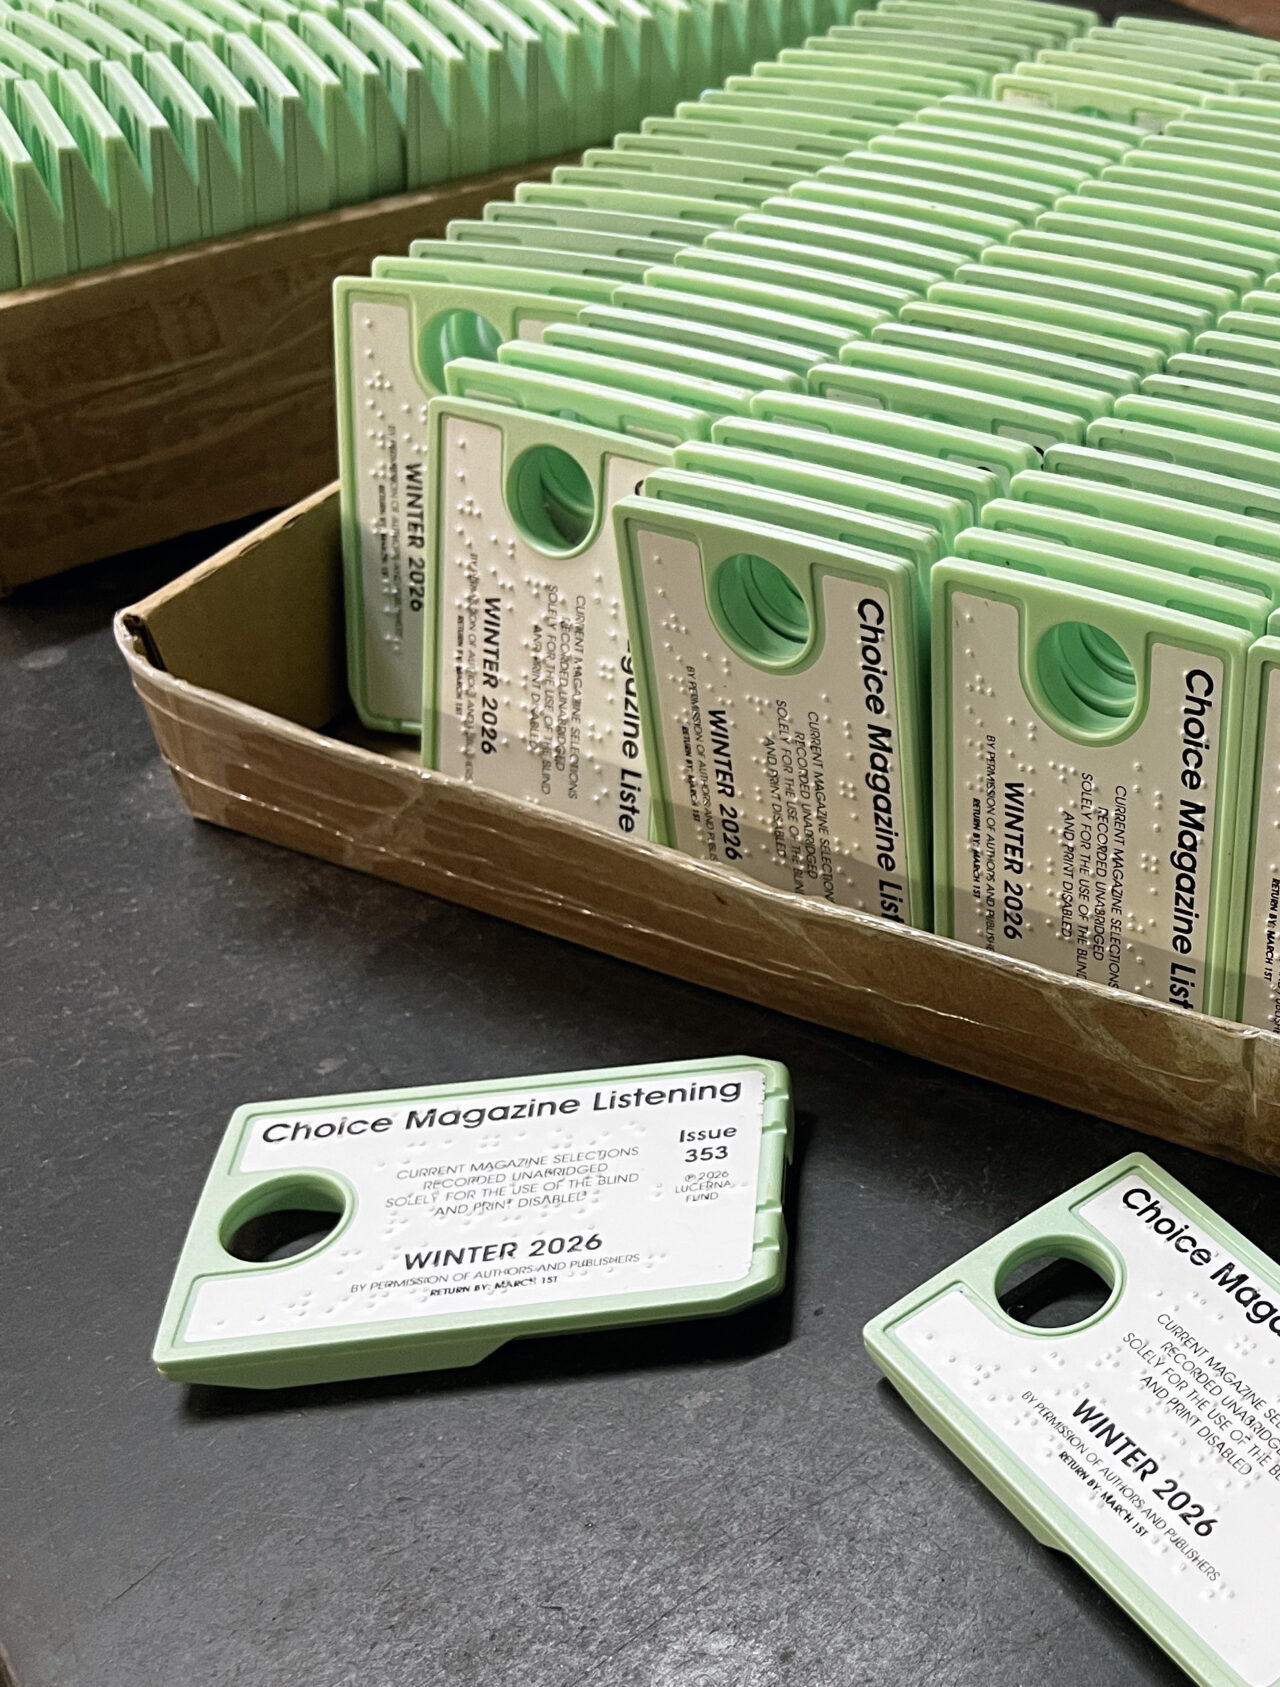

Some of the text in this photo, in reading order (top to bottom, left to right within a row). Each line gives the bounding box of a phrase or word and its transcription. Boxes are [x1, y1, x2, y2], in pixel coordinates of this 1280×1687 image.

[479, 596, 501, 755] WINTER 2026
[857, 597, 889, 717] Choice
[1179, 668, 1214, 793] Choice
[706, 709, 743, 861] WINTER 2026
[863, 722, 899, 872] Magazine
[1079, 771, 1093, 820] SOLELY
[1112, 784, 1127, 846] CURRENT
[1003, 781, 1024, 940] WINTER 2026
[1078, 853, 1091, 875] THE
[1079, 822, 1092, 850] FOR
[1077, 877, 1090, 902] USE
[1110, 847, 1124, 915] MAGAZINE
[1168, 798, 1207, 955] Magazine
[1076, 924, 1089, 946] THE
[1077, 903, 1089, 923] OF
[1263, 876, 1280, 981] RETURN BY: MARCH 1ST
[260, 1081, 742, 1144] Choice Magazine Listening
[678, 1126, 737, 1143] Issue
[395, 1145, 639, 1180] CURRENT MAGAZINE SELECTIONS
[673, 1179, 731, 1193] LUCERNA
[683, 1144, 728, 1163] 353
[444, 1188, 476, 1202] FOR
[481, 1185, 506, 1198] THE
[510, 1182, 538, 1195] USE
[567, 1176, 592, 1188] THE
[596, 1171, 639, 1186] BLIND
[684, 1190, 719, 1202] FUND
[404, 1231, 603, 1271] WINTER 2026
[1121, 1186, 1219, 1266] Choice
[1156, 1312, 1209, 1357] CURRENT
[1203, 1355, 1267, 1411] MAGAZINE
[1159, 1340, 1223, 1396] RECORDED
[1121, 1331, 1165, 1368] SOLELY
[1160, 1366, 1189, 1391] FOR
[1185, 1388, 1210, 1411] THE
[1206, 1406, 1232, 1431] USE
[1228, 1428, 1251, 1445] OF
[1246, 1442, 1272, 1466] THE
[1139, 1375, 1253, 1475] AND PRINT DISABLED
[1020, 1389, 1221, 1581] BY PERMISSION OF AUTHORS AND PUBLISHERS
[1057, 1449, 1149, 1537] RETURN BY: MARCH 1ST
[1071, 1397, 1219, 1537] WINTER 2026
